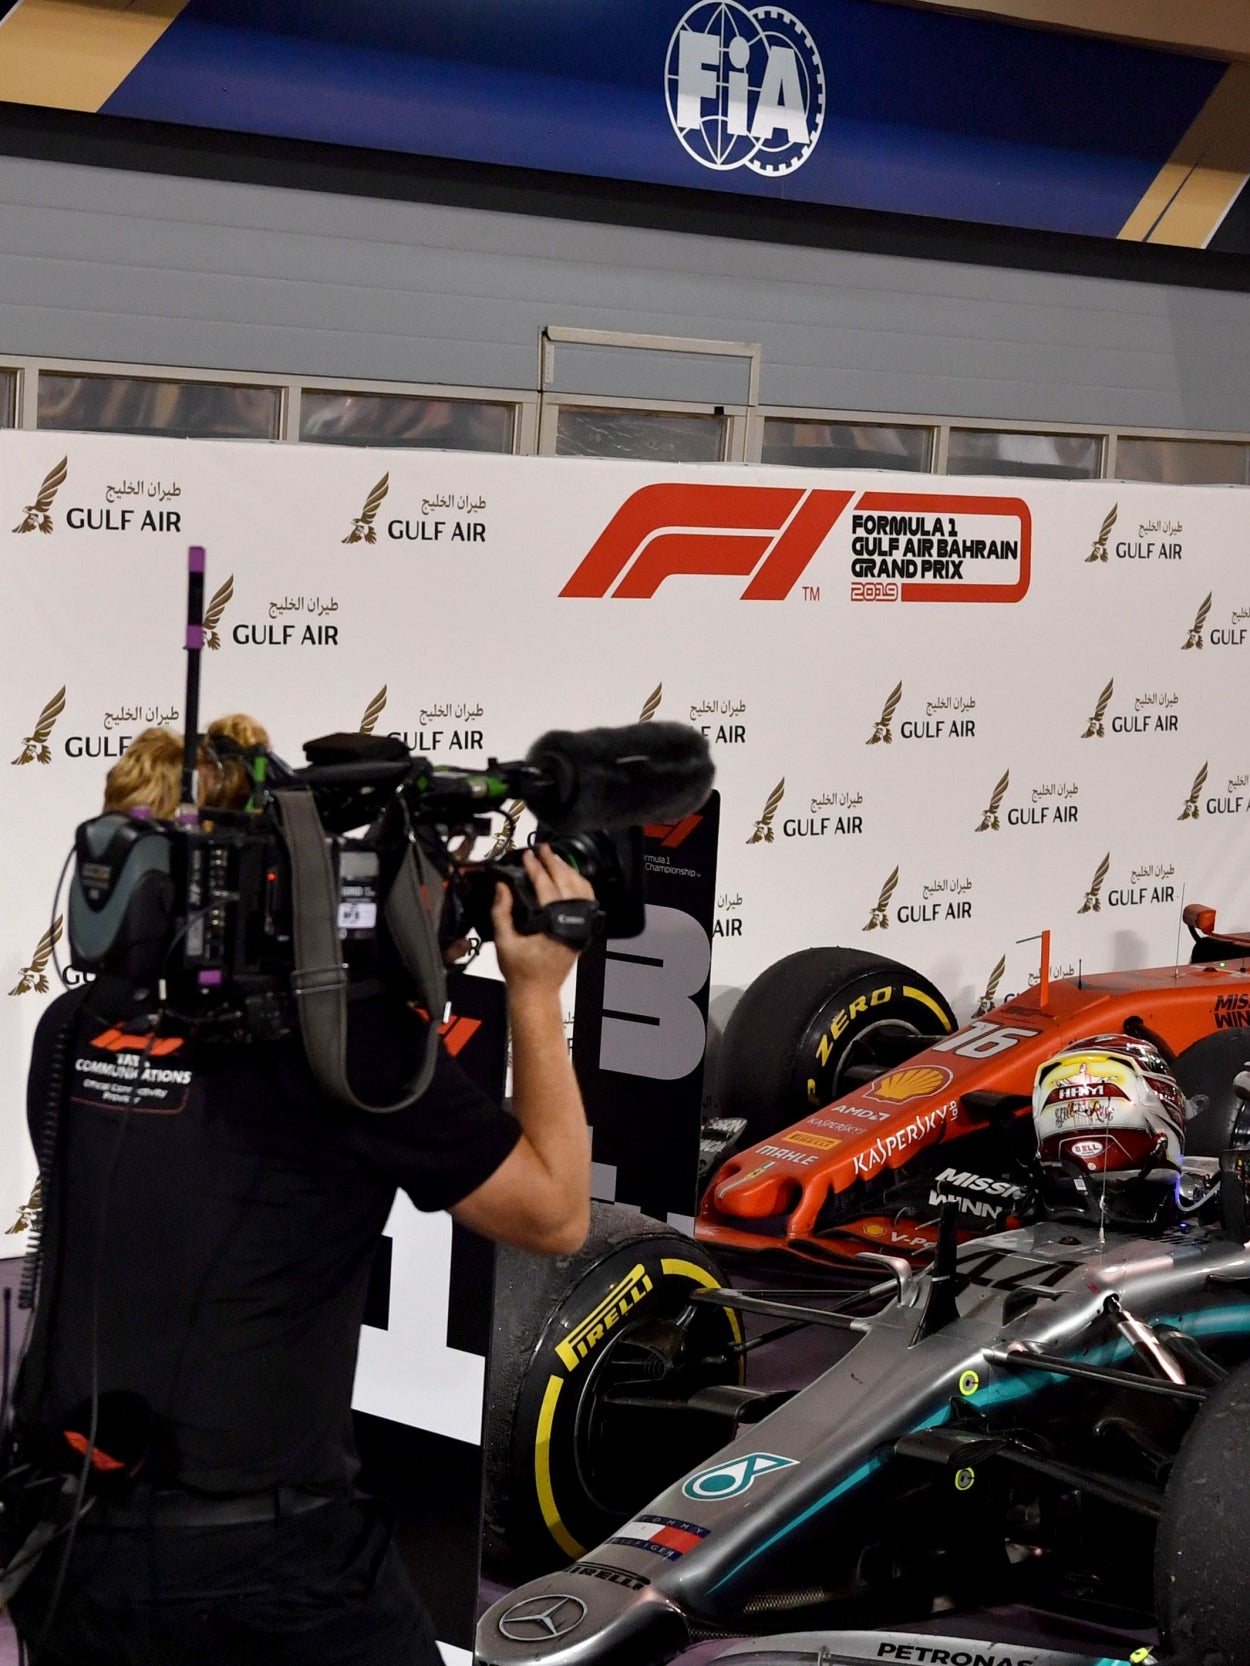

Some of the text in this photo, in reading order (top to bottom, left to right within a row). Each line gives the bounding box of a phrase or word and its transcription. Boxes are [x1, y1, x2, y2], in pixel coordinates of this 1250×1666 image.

[106, 480, 182, 503] طيران الخليج
[421, 495, 487, 516] طيران الخليج
[66, 507, 181, 533] GULF AIR
[852, 515, 958, 537] FORMULA 1
[1138, 520, 1183, 539] طيران الخليج
[387, 520, 486, 543] GULF AIR
[852, 537, 1019, 560] GULF AIR BAHRAIN
[1115, 542, 1183, 560] GULF AIR
[851, 558, 964, 580] GRAND PRIX
[850, 582, 899, 602] 2019
[268, 597, 339, 618] طيران الخليج
[232, 624, 339, 646] GULF AIR
[1210, 628, 1247, 646] GULF
[689, 700, 746, 721] طيران الخليج
[926, 696, 976, 717] طيران الخليج
[1134, 692, 1179, 712] طيران الخليج
[103, 706, 180, 730] طيران الخليج
[419, 703, 484, 726] طيران الخليج
[1111, 714, 1179, 733] GULF AIR
[715, 725, 746, 744] AIR
[900, 720, 976, 739] GULF AIR
[64, 736, 132, 758] GULF
[386, 730, 484, 752] ULF AIR
[810, 792, 863, 811] طيران الخليج
[1031, 783, 1079, 803] طيران الخليج
[1007, 805, 1078, 826] GULF AIR
[1206, 796, 1243, 814] GULF
[783, 816, 863, 838] GULF AIR
[1130, 864, 1175, 885] طيران الخليج
[922, 878, 973, 898] طيران الخليج
[1108, 886, 1175, 907] GULF AIR
[897, 901, 972, 924] GULF AIR
[713, 917, 743, 938] AIR
[599, 903, 711, 1081] 3
[816, 986, 892, 1067] ZERO
[930, 1021, 1043, 1060] 16
[75, 1058, 192, 1085] COMMUNIATIONS
[854, 1105, 948, 1175] KASPERSKY
[756, 1144, 819, 1166] MAHLE
[935, 1168, 1020, 1198] MISSI
[928, 1189, 1003, 1220] WINN
[554, 1263, 654, 1372] PIRELLI
[877, 1641, 1034, 1666] PETRONAS
